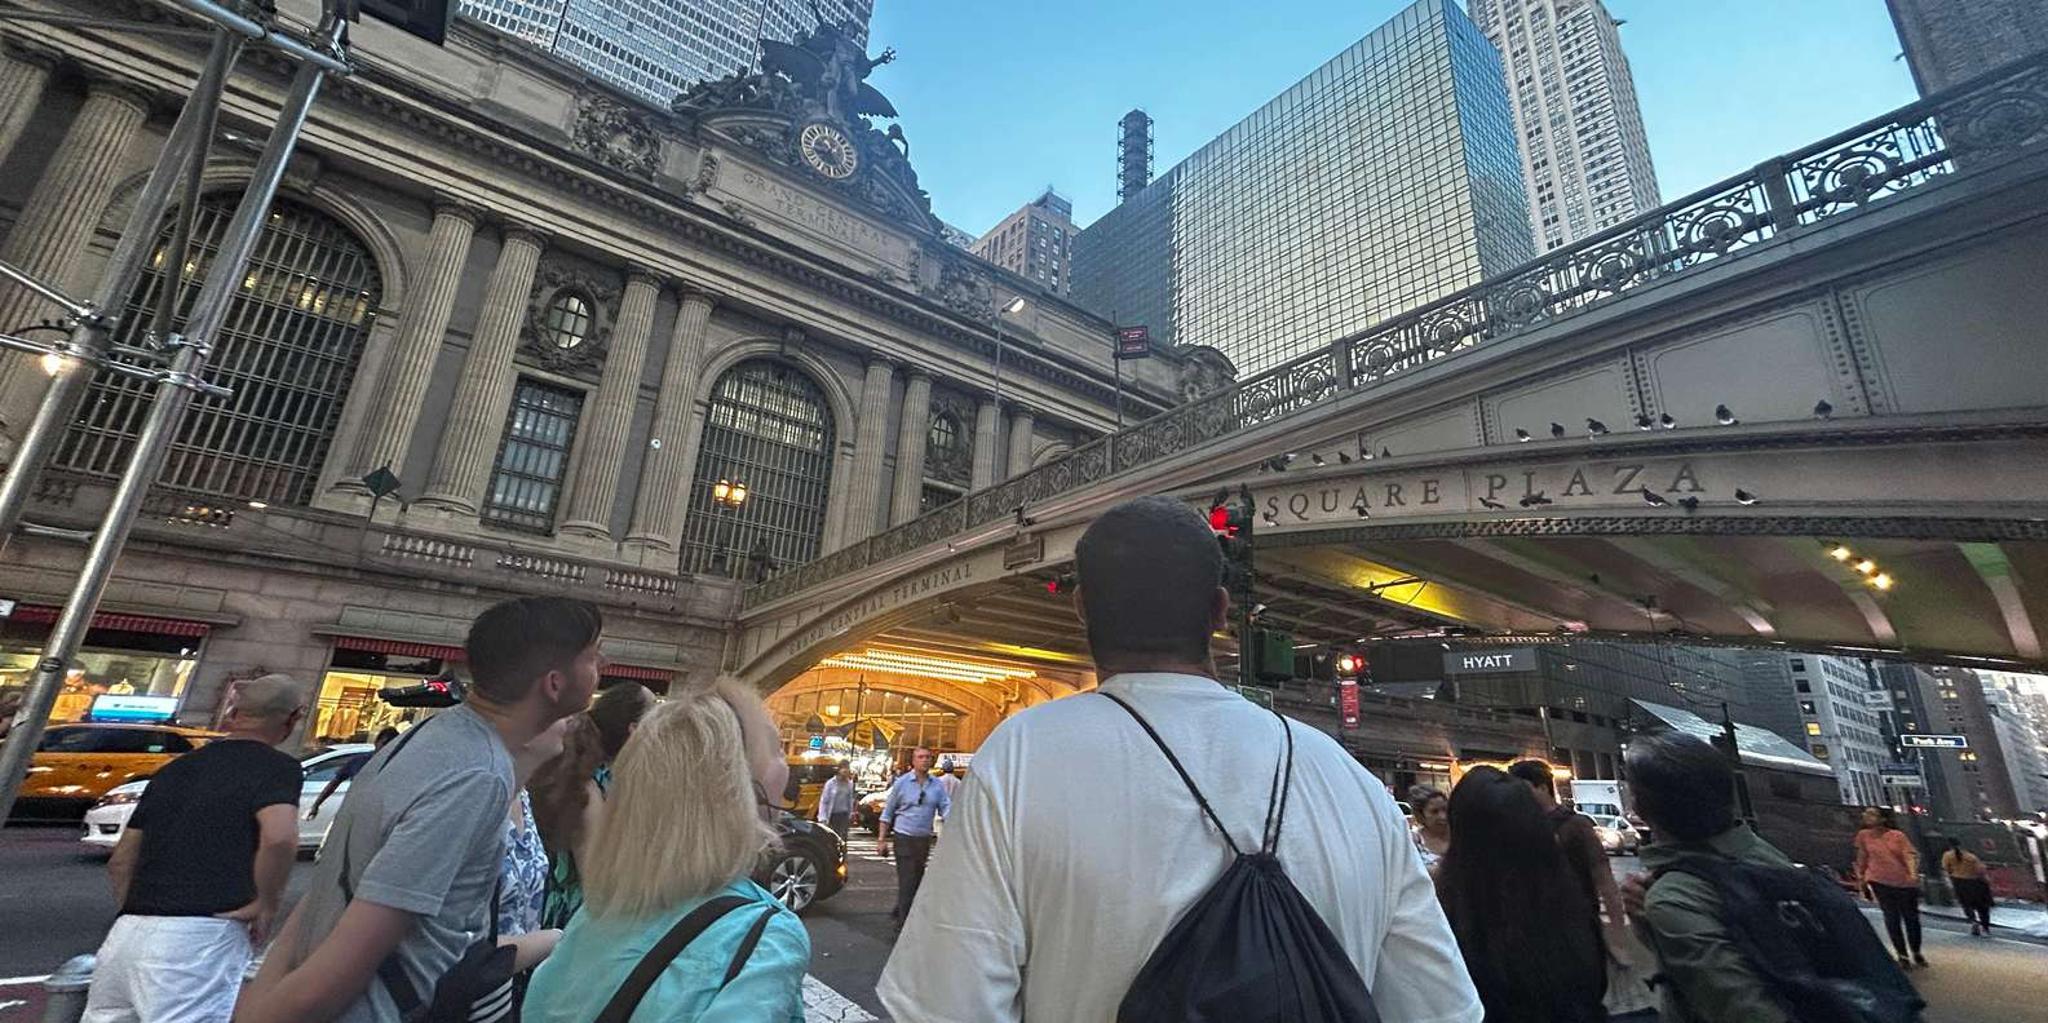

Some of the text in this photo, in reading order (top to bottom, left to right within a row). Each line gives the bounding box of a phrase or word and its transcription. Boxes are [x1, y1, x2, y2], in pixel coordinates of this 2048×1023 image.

[743, 173, 806, 206] GRAND
[775, 199, 860, 244] TERMINAL
[1266, 463, 1705, 521] SQUARE PLAZA
[893, 563, 973, 603] TERMINAL
[1463, 654, 1513, 669] HYATT
[1912, 737, 1935, 745] Park
